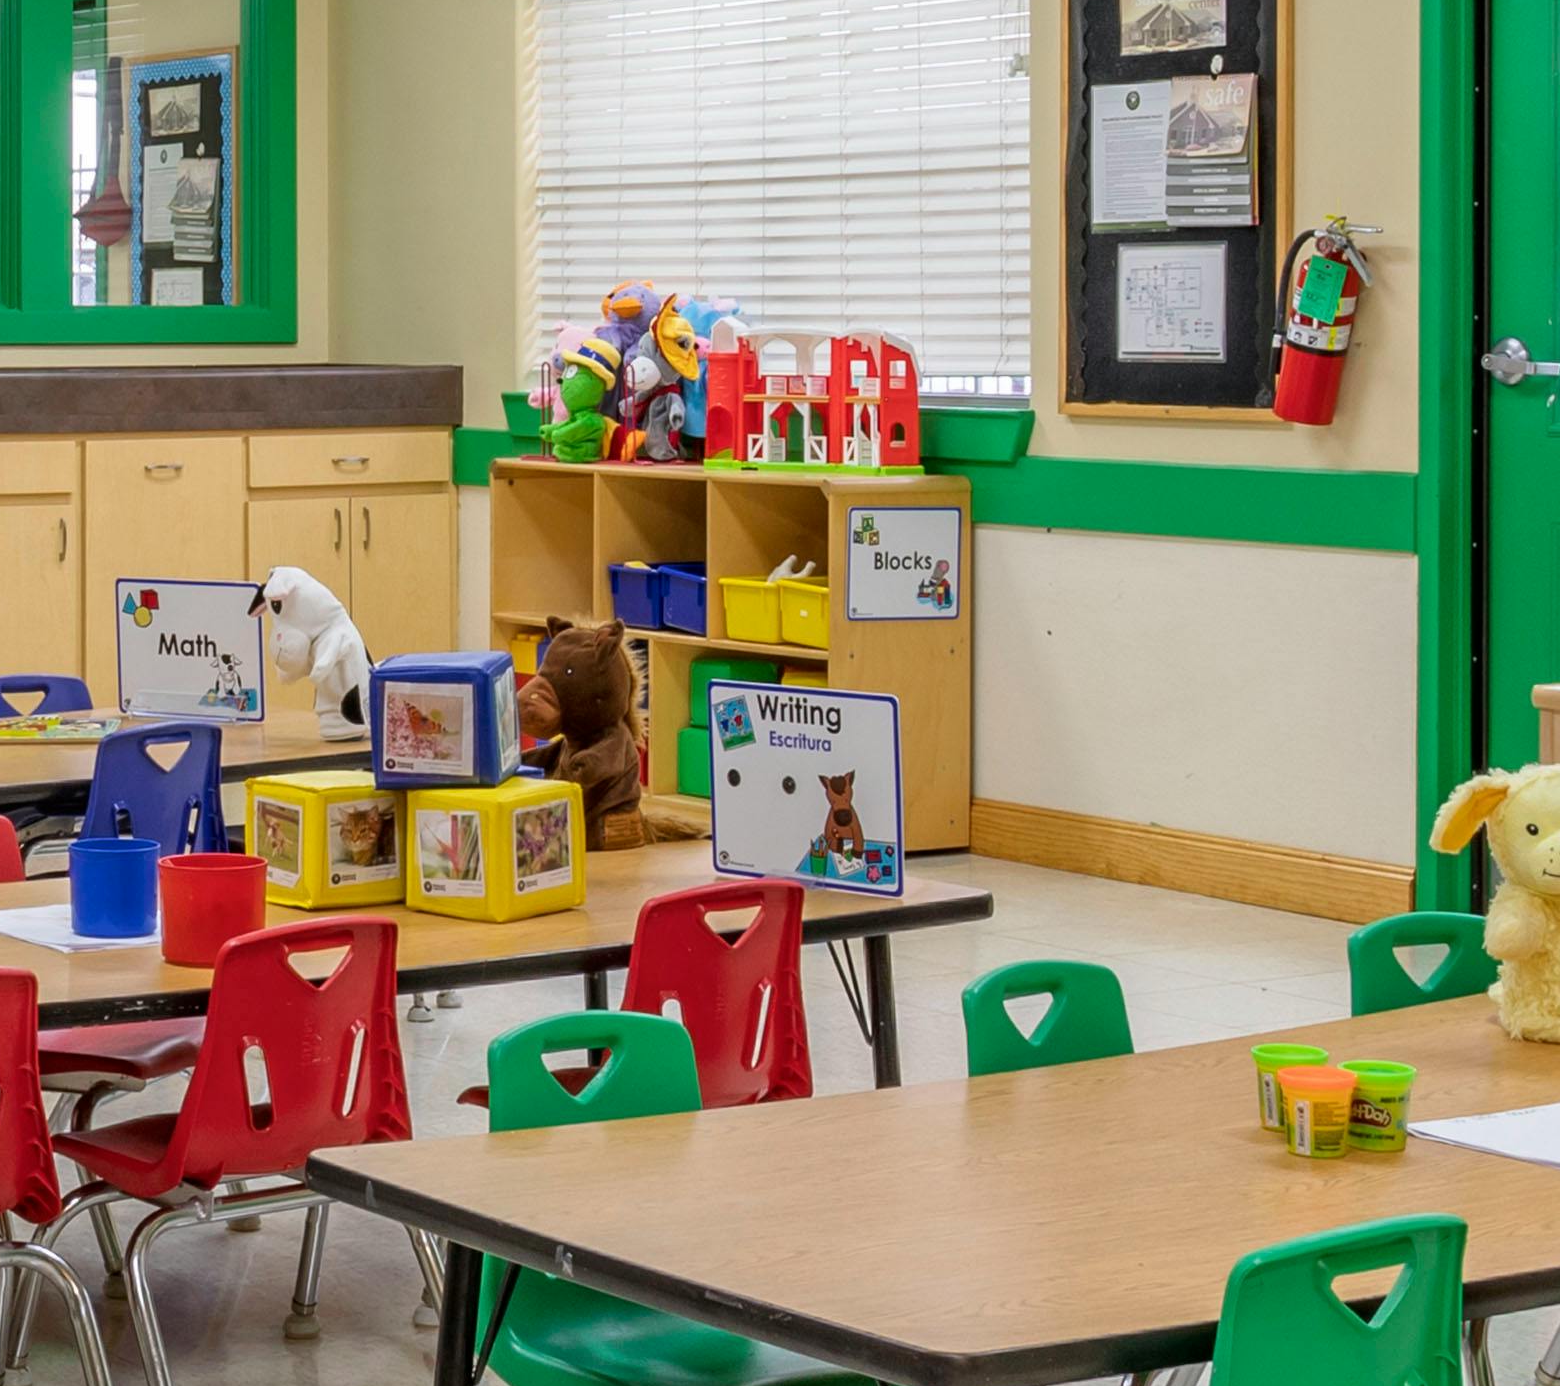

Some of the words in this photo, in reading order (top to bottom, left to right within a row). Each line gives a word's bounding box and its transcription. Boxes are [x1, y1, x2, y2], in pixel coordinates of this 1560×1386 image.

[1205, 79, 1245, 107] safe
[873, 551, 933, 571] Blocks
[157, 632, 217, 658] Math
[757, 693, 843, 734] Writing
[769, 730, 832, 752] Escritura
